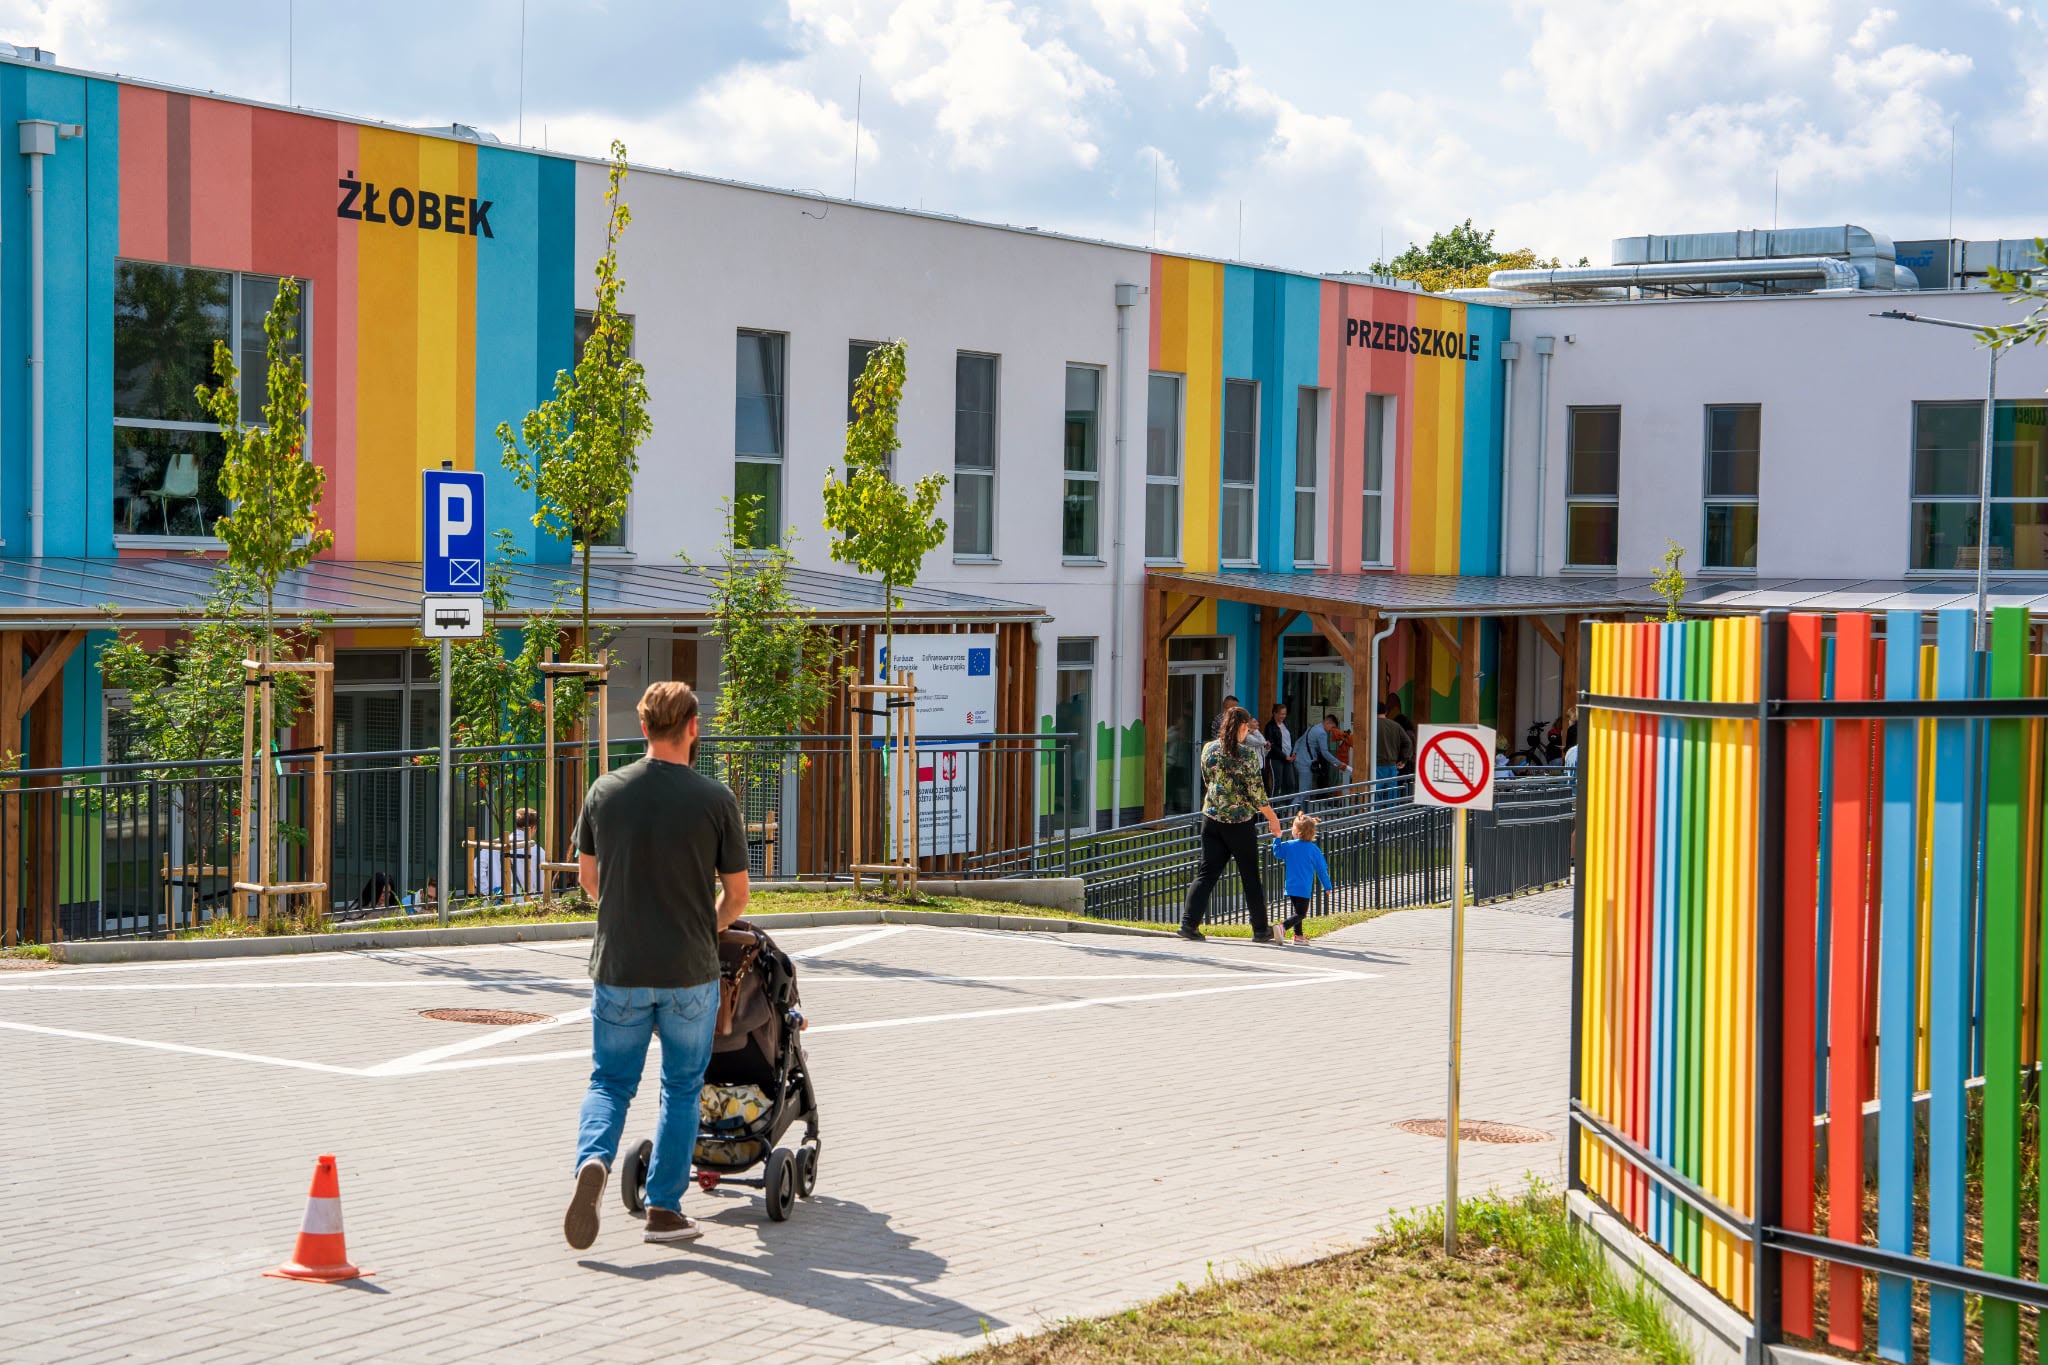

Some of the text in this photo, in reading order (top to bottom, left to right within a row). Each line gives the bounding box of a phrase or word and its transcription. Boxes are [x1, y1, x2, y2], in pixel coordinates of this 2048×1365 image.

[337, 170, 494, 239] ŻŁOBEK
[1346, 318, 1480, 361] PRZEDSZKOLE
[439, 482, 472, 557] P
[893, 654, 914, 662] Fundusze
